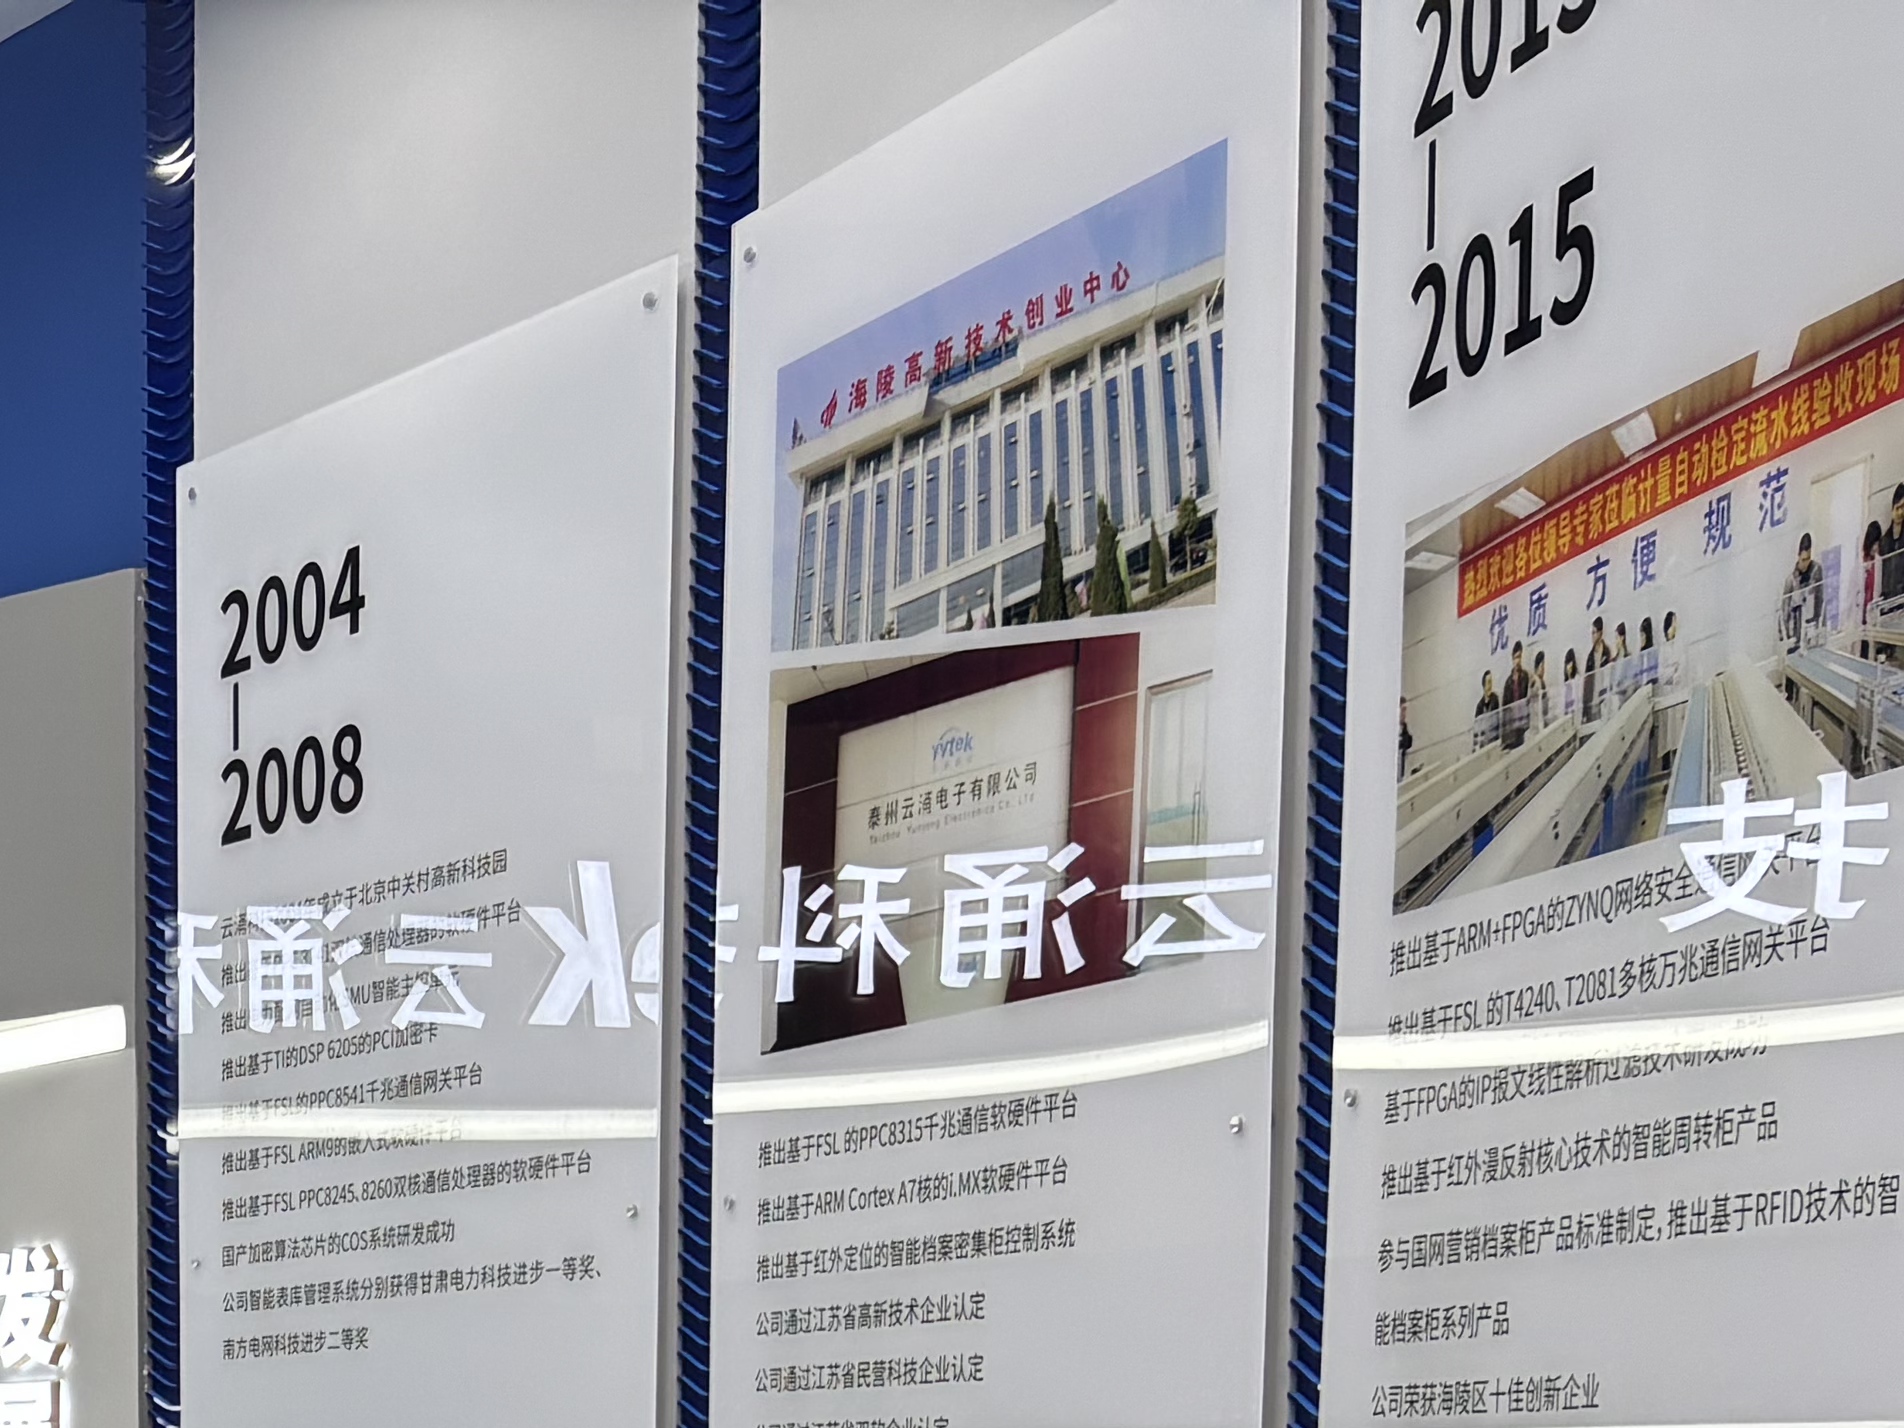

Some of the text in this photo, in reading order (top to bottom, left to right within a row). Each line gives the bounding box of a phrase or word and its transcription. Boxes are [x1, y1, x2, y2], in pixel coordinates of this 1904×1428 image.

[1409, 166, 1594, 409] 2015
[847, 261, 1130, 413] 海陵高新技术创业中心
[1586, 528, 1659, 612] 方便
[1702, 465, 1790, 555] 规范
[220, 545, 366, 680] 2004
[220, 723, 365, 847] 2008
[868, 761, 1038, 831] 泰州云涌电子有限公司
[1381, 1101, 1779, 1199] 推出基于红外漫反射核心技术的智能周转柜产品
[848, 1180, 895, 1212] Cortex
[221, 1219, 455, 1268] 国产加密算法芯片的COS系统研发成功
[756, 1217, 1077, 1283] 推出基于红外定位的智能档案密集柜控制系统
[222, 1327, 370, 1361] 南方电网科技进步二等奖
[756, 1291, 986, 1338] 公司通过江苏省高新技术企业认定
[1374, 1301, 1511, 1347] 能档案柜系列产品
[755, 1353, 985, 1393] 公司通过江苏省民营科技企业认定
[1371, 1372, 1601, 1419] 公司荣获海陵区十佳创新企业
